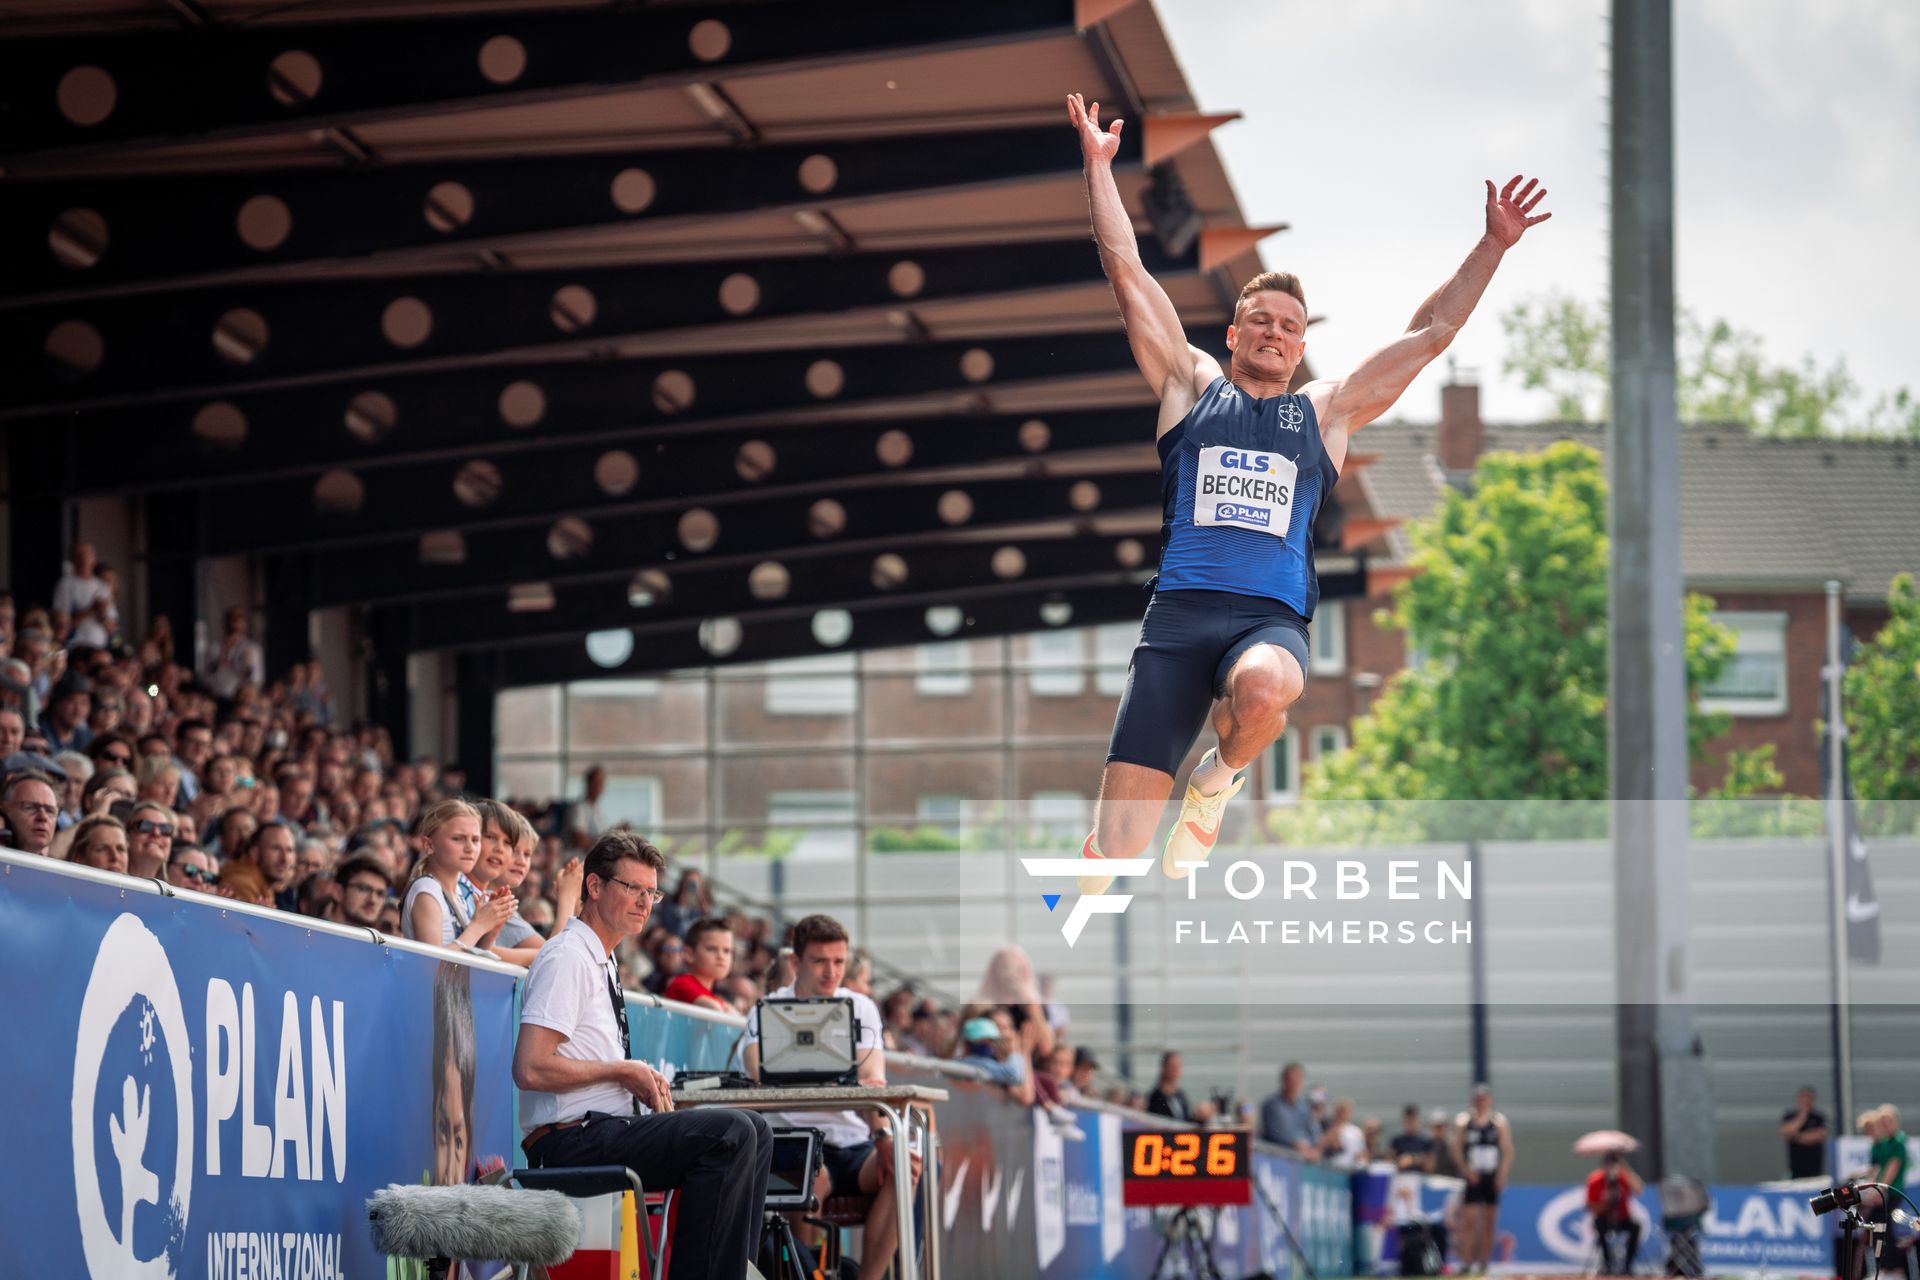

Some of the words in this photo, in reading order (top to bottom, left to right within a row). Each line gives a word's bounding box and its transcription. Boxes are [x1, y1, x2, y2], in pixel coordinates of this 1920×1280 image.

[1280, 421, 1301, 433] LAV
[1202, 474, 1289, 506] BECKERS
[1238, 507, 1269, 521] PLAN
[206, 977, 347, 1184] PLAN
[1132, 1133, 1237, 1177] 0:26
[1700, 1195, 1824, 1240] LAN
[207, 1231, 345, 1280] INTERNATIONAL
